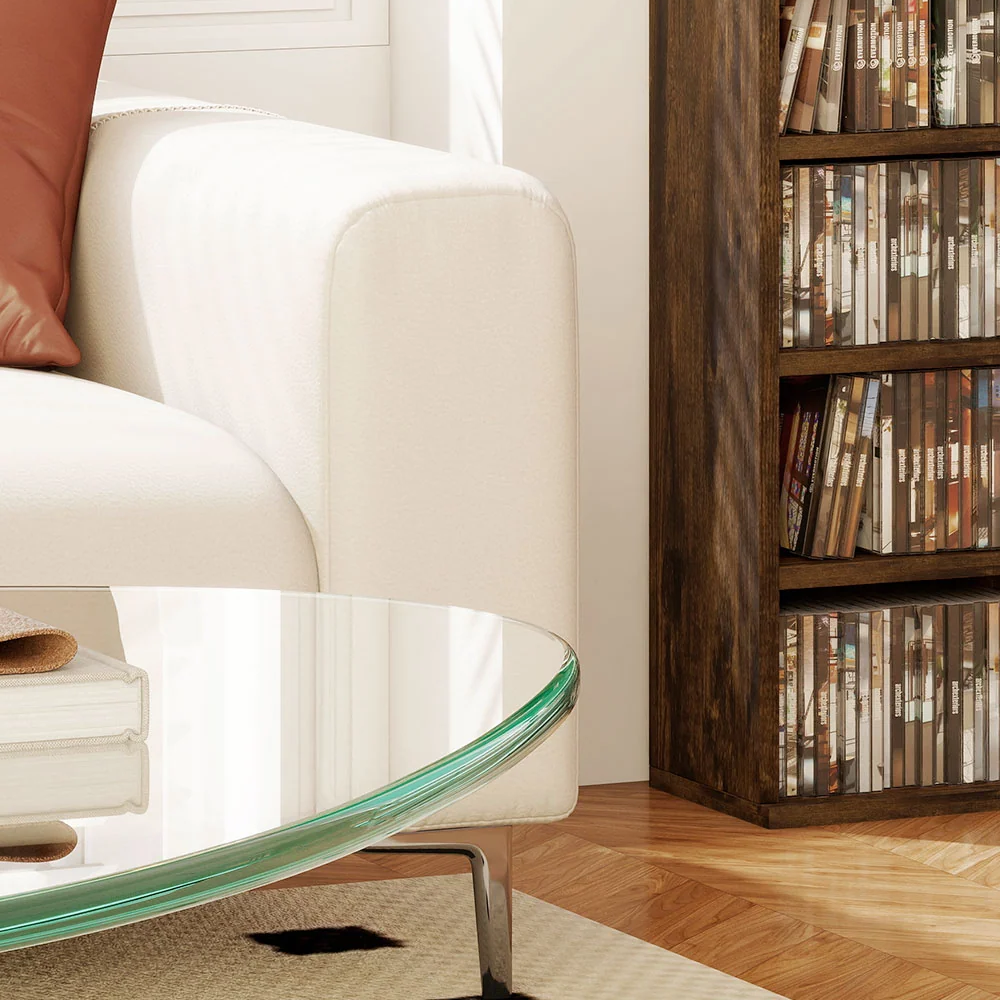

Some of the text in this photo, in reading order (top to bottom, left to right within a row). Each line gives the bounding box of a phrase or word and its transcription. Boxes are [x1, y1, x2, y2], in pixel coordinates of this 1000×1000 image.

[834, 25, 843, 60] EVERMOTION
[890, 238, 898, 271] archexteriors
[898, 449, 906, 482] archexteriors
